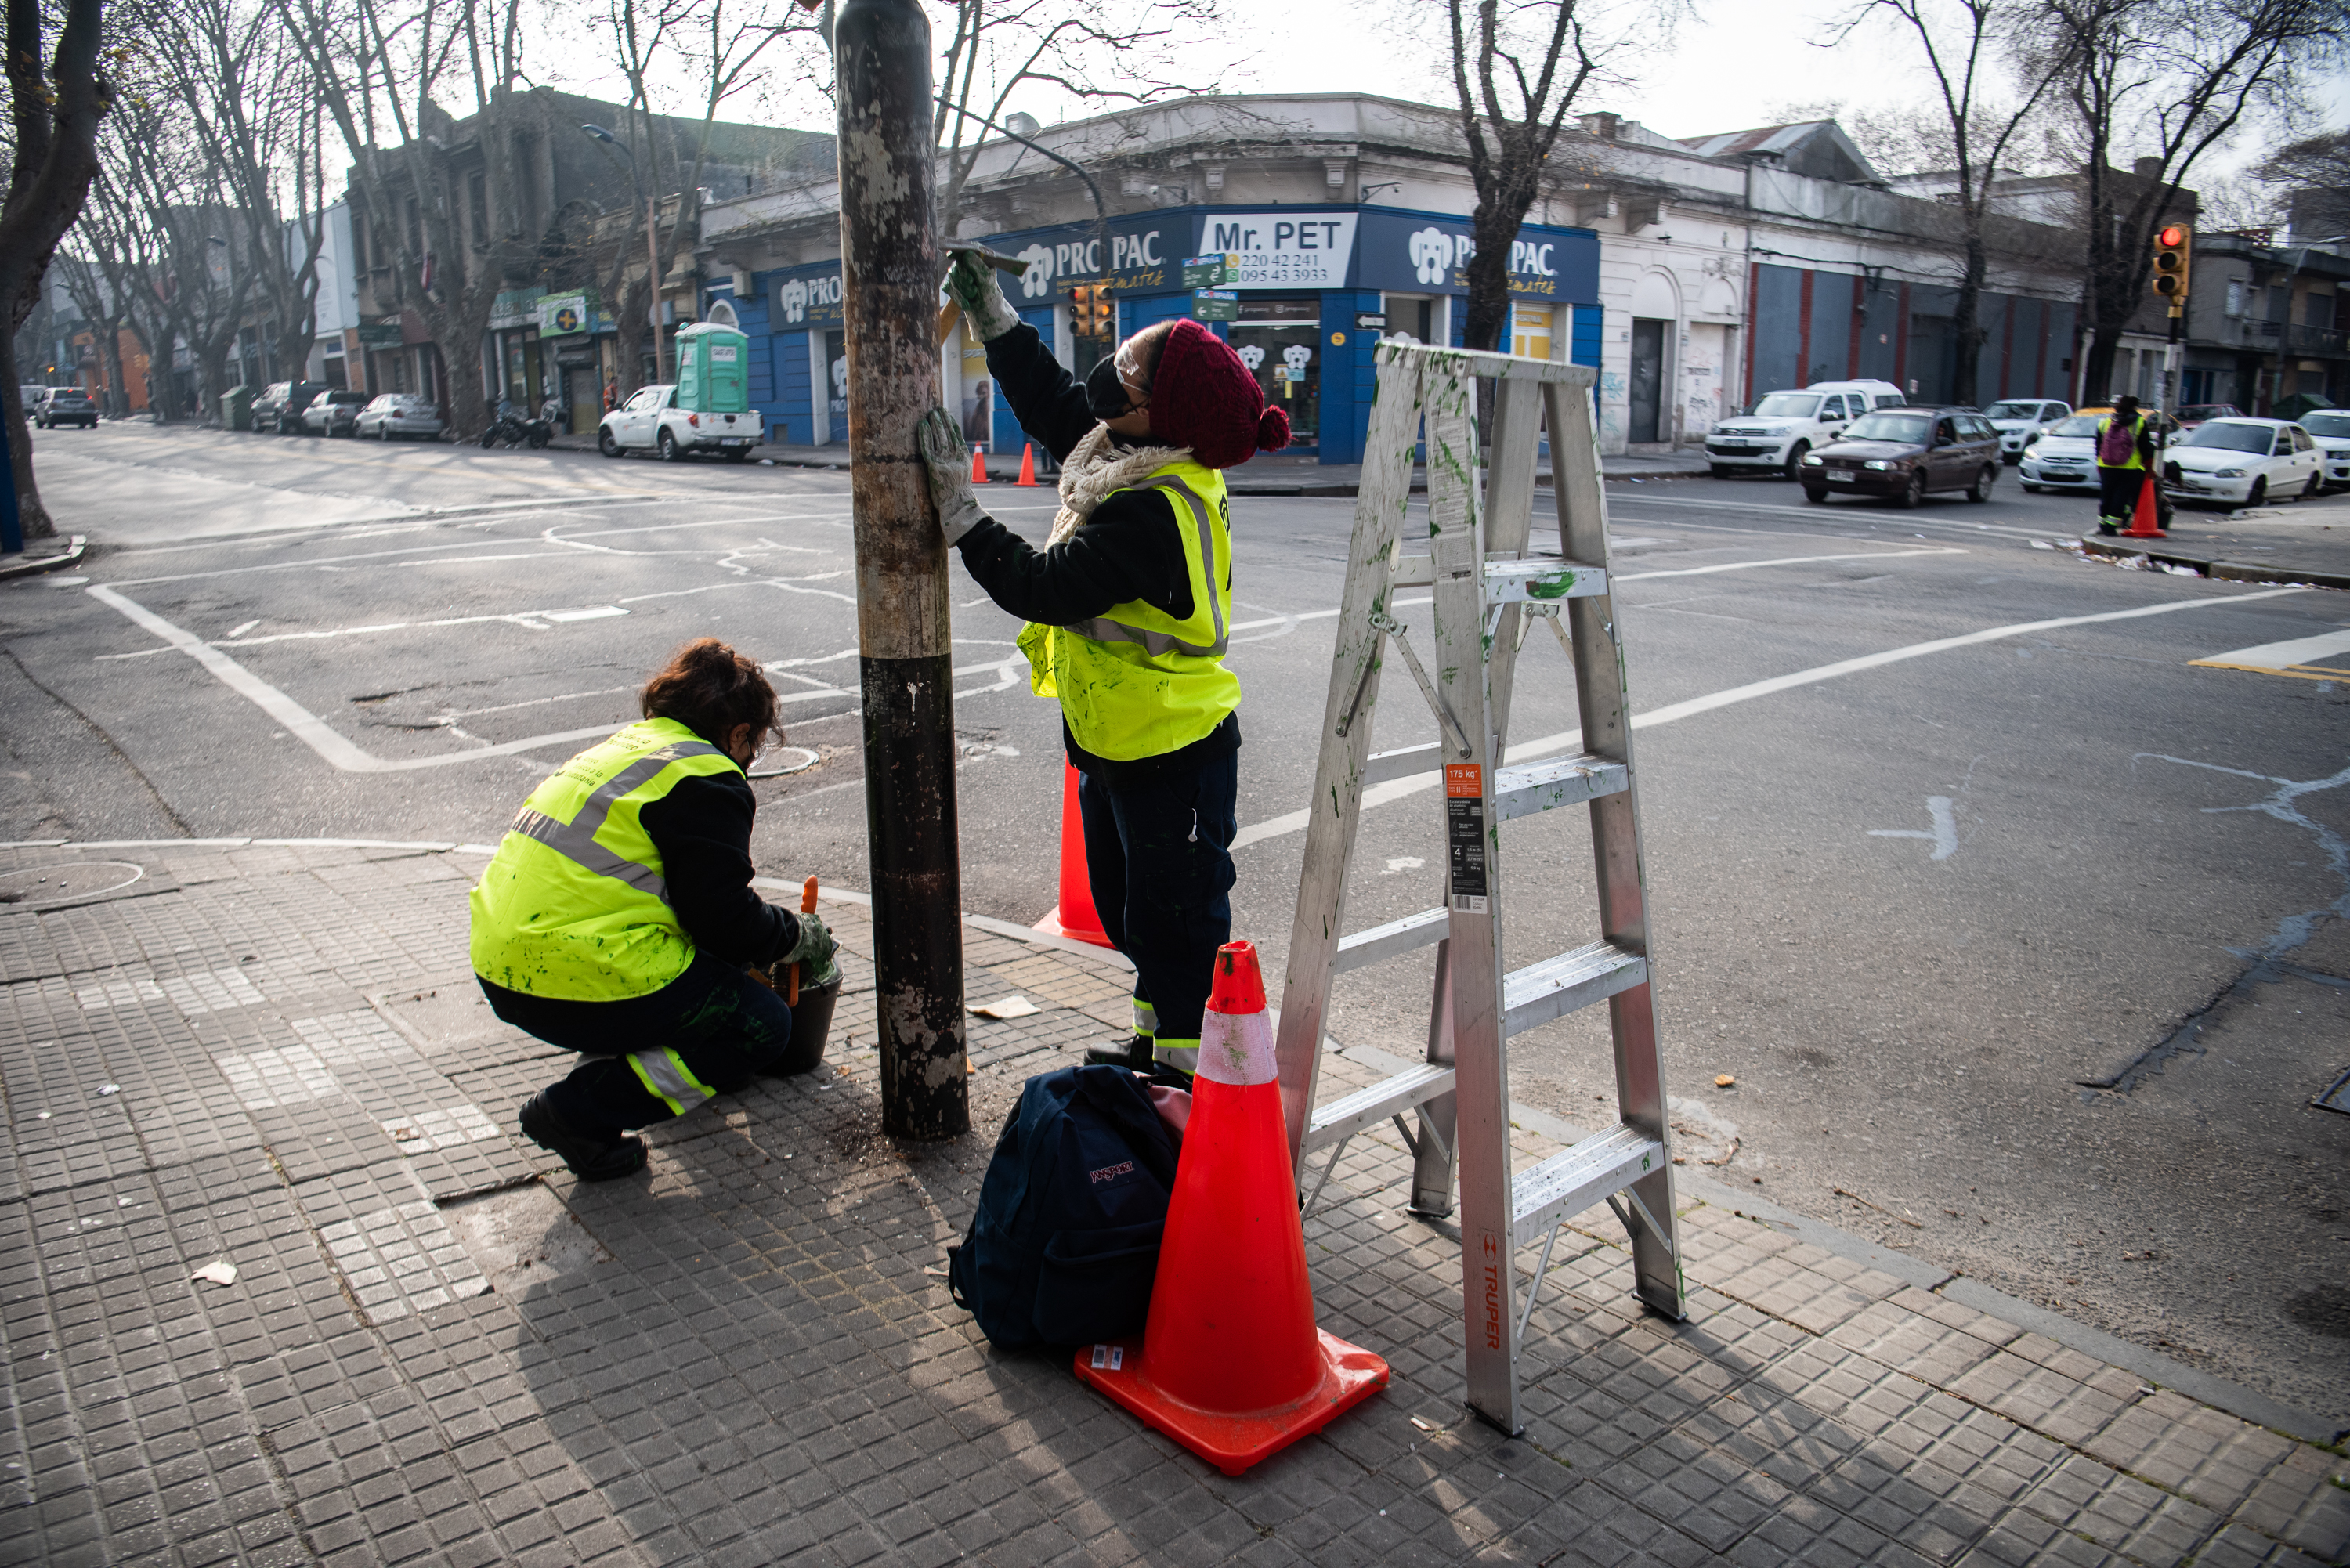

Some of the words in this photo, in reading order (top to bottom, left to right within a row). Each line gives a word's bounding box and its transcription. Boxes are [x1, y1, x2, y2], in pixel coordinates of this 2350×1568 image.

[1215, 222, 1261, 251] Mr.
[1275, 221, 1342, 250] PET
[1112, 231, 1162, 270] PAC
[1242, 255, 1268, 267] 220
[1271, 255, 1289, 266] 42
[1292, 254, 1318, 266] 241
[1511, 240, 1555, 276] PAC
[1241, 269, 1268, 282] 095
[1271, 269, 1289, 281] 43
[1292, 269, 1328, 282] 3933
[808, 276, 843, 306] PRO
[1450, 769, 1463, 778] 175
[1454, 847, 1461, 857] 4
[1090, 1160, 1133, 1183] JANSPORT
[1485, 1264, 1500, 1350] TRUPER
